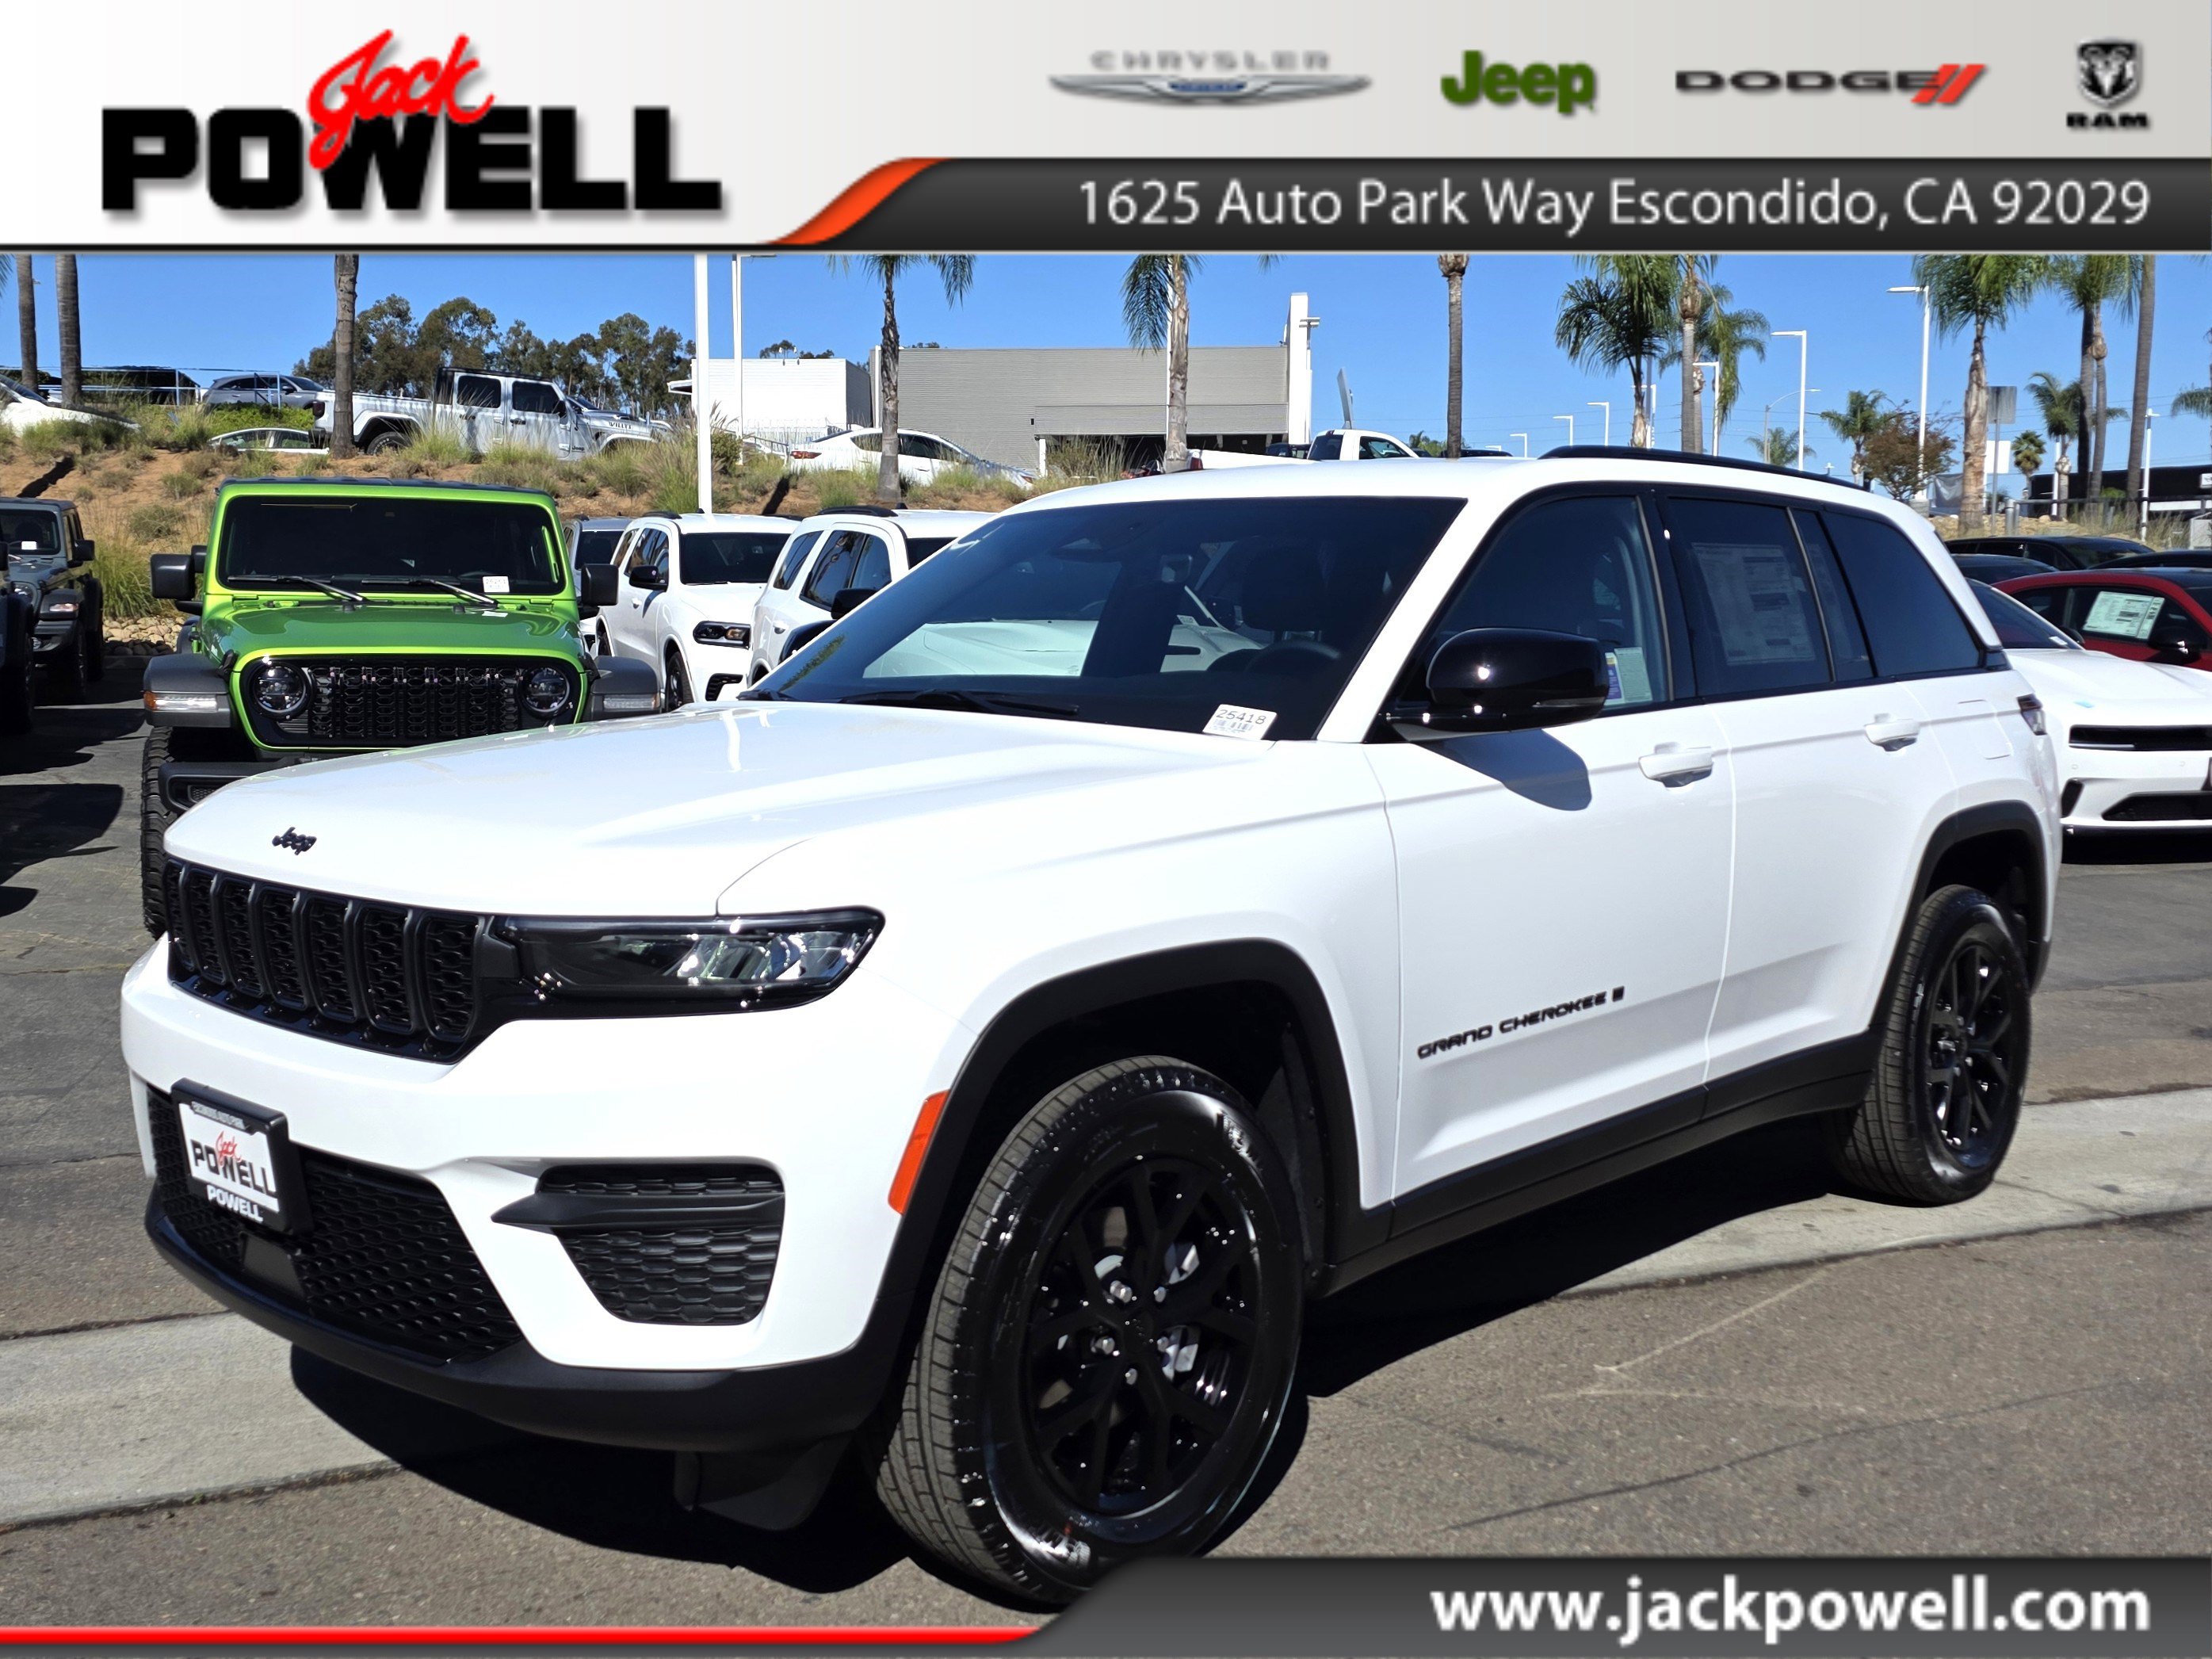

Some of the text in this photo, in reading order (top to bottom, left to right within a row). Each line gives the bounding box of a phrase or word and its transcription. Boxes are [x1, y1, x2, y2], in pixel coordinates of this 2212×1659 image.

[1216, 709, 1266, 724] 25418
[272, 827, 317, 855] Jeep
[1417, 991, 1607, 1059] GRAND CHEROKEE
[190, 1139, 277, 1199] POWELL
[206, 1184, 263, 1224] POWELL
